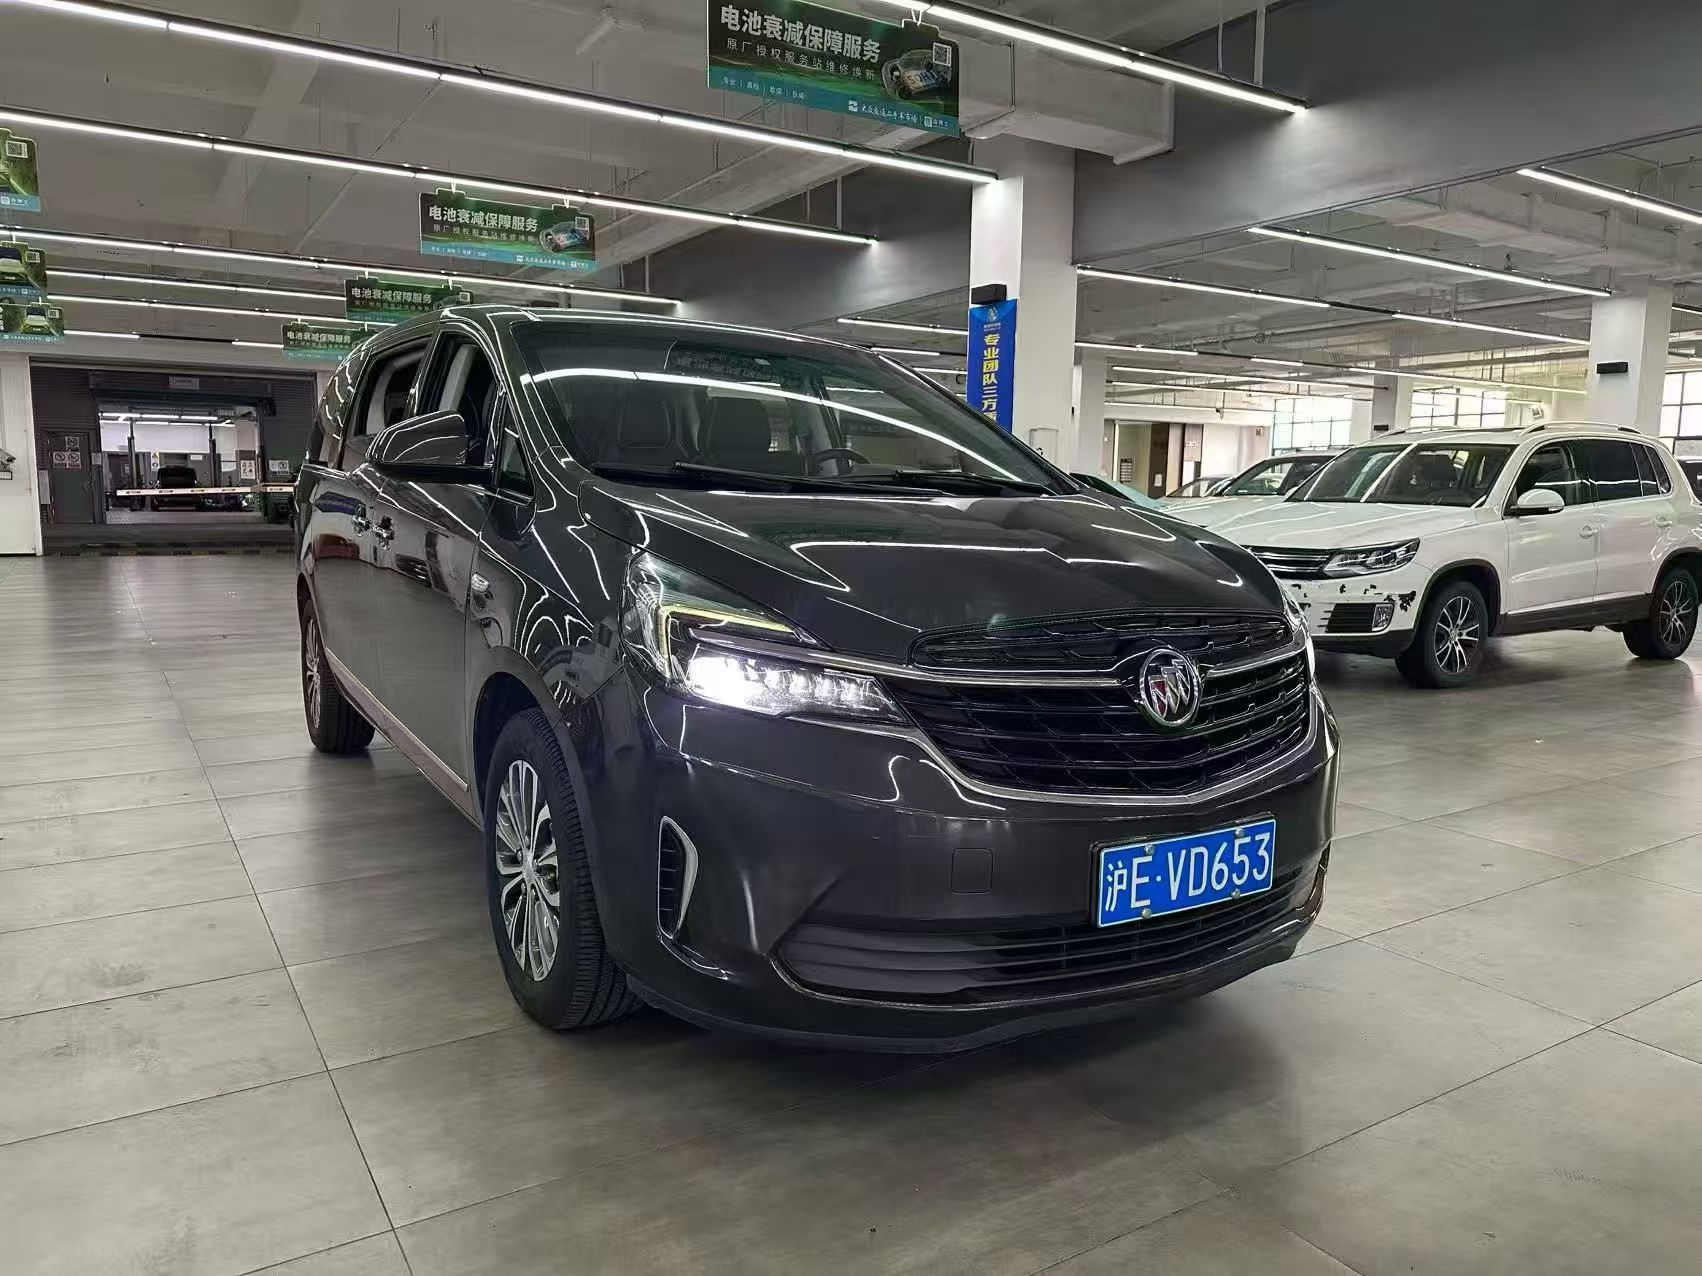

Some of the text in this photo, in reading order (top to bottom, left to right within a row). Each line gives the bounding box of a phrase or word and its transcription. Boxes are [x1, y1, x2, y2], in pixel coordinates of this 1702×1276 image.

[721, 5, 881, 63] 电池衰减保障服务
[727, 37, 875, 80] 原厂授权服务站维修换新
[429, 205, 538, 232] 电池衰减保障服务
[351, 287, 432, 304] 电池衰减保障服务
[1105, 832, 1271, 912] 沪E·VD653
